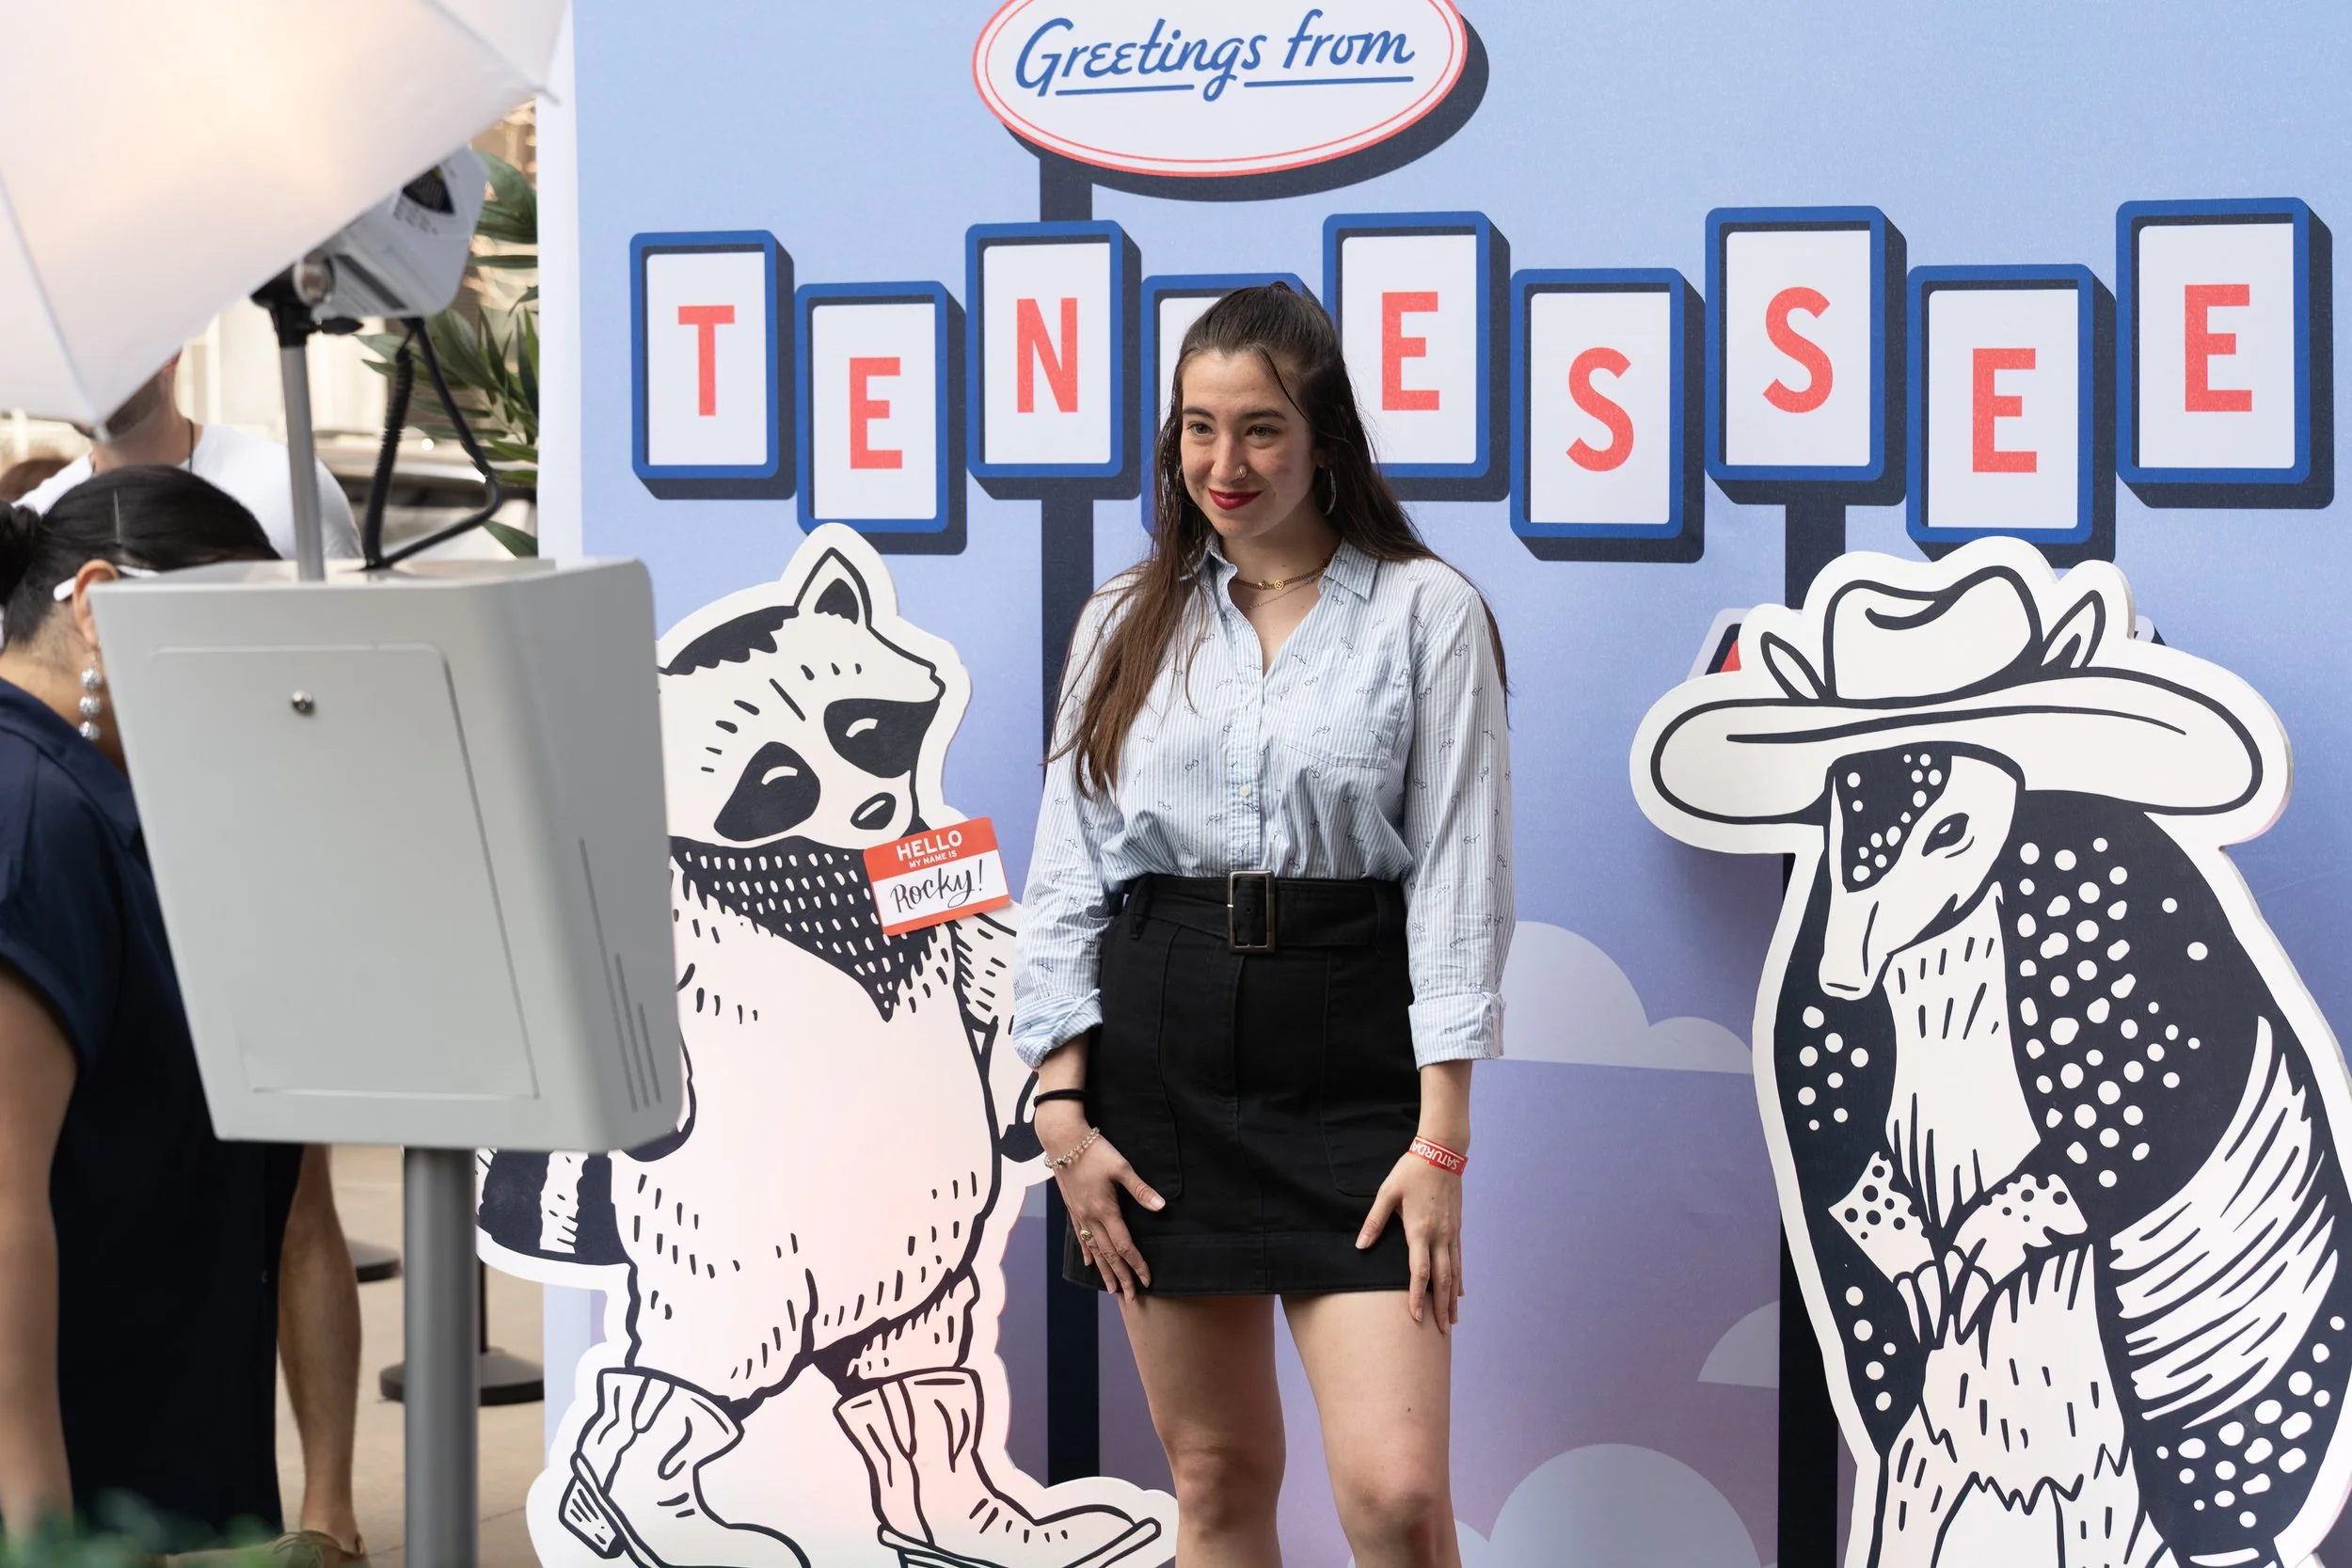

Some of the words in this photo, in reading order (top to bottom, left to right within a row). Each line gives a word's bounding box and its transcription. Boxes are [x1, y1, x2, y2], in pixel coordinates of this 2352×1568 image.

[1016, 17, 1267, 102] Greetings
[1282, 8, 1415, 70] from
[678, 284, 2252, 472] TENESSEE
[896, 830, 962, 862] HELLO
[909, 859, 921, 868] MY
[923, 852, 947, 864] NAME
[948, 849, 957, 858] IS
[890, 859, 982, 913] Rocky!
[1410, 1141, 1460, 1170] SATURDA
